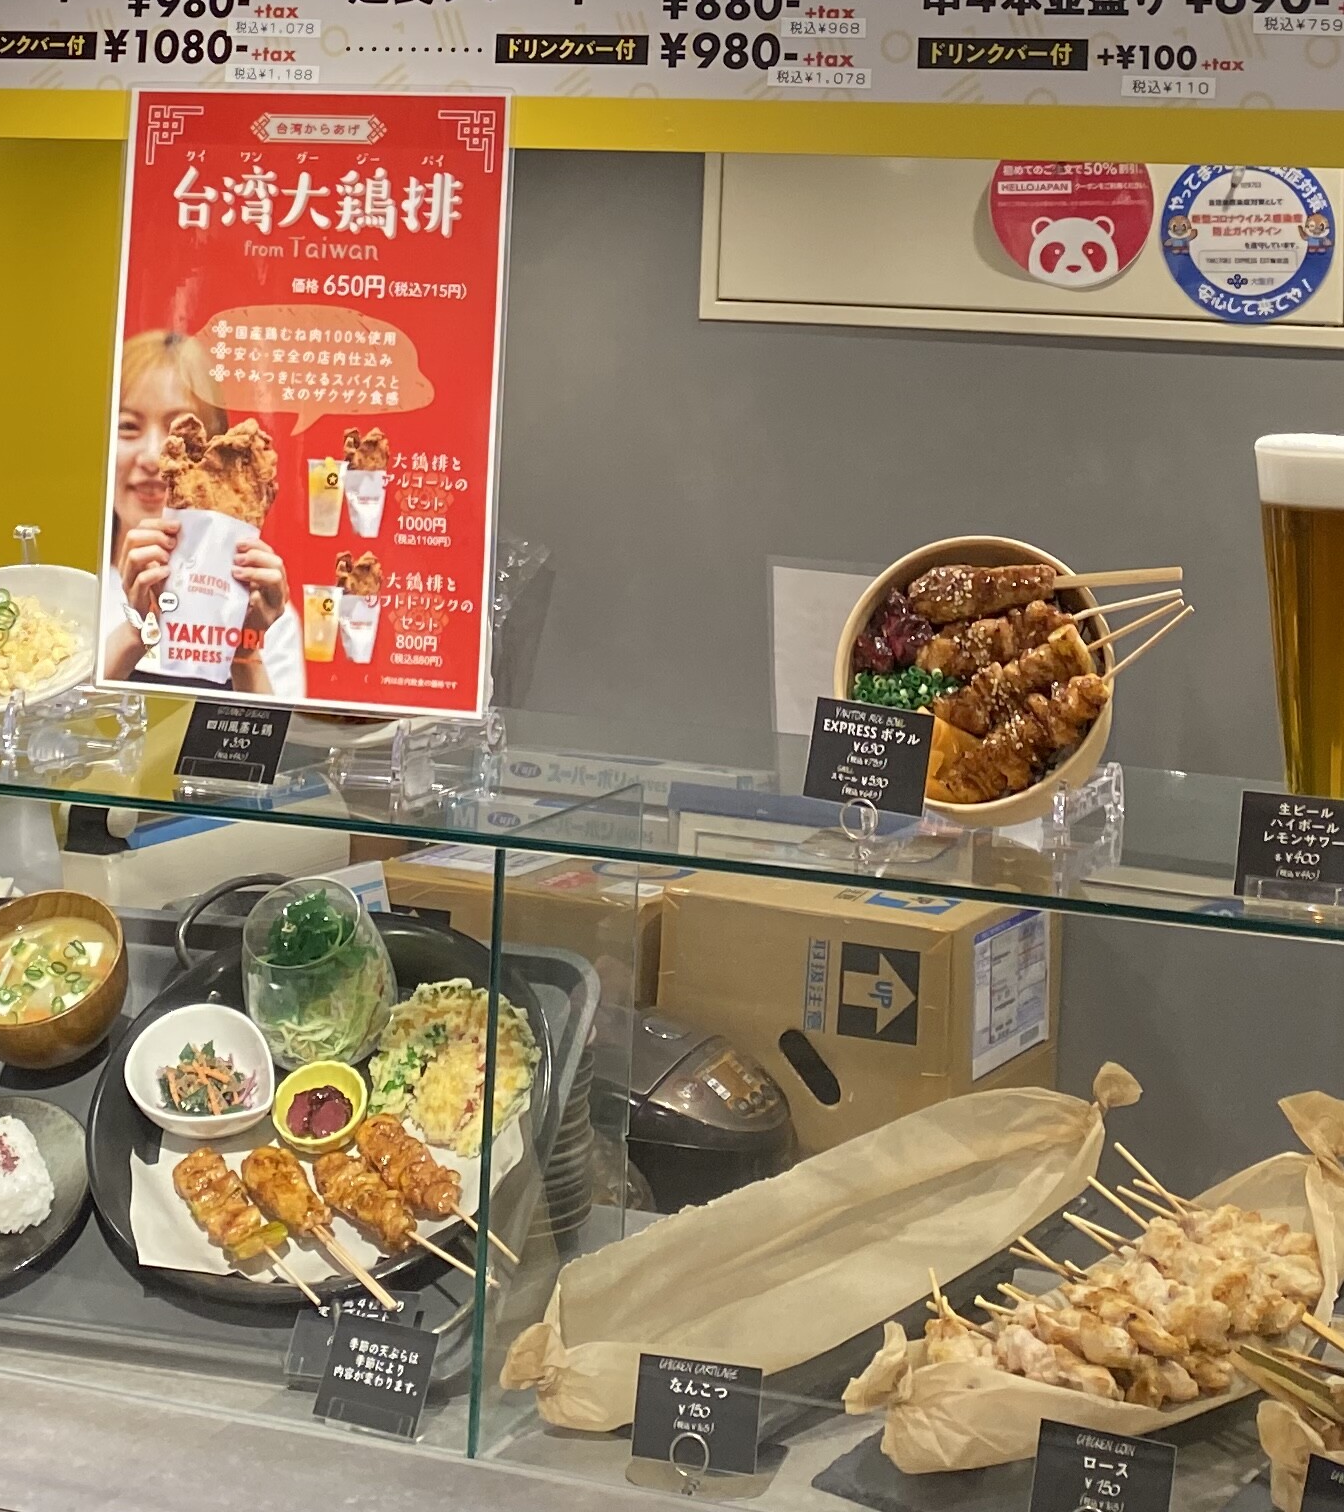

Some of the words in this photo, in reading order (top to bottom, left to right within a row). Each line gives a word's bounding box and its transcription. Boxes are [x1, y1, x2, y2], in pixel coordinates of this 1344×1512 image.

[254, 3, 299, 20] +tax
[805, 4, 855, 19] +tax
[789, 20, 861, 36] 税込¥968
[1263, 16, 1344, 32] 税込¥759
[251, 46, 297, 63] +tax
[507, 38, 636, 61] ドリンクバー付
[802, 50, 854, 68] +tax
[929, 43, 1073, 65] ドリンクバー付
[1097, 45, 1197, 72] +¥100
[1201, 57, 1244, 72] +tax
[1132, 79, 1209, 96] 税込¥110
[276, 122, 361, 137] 台湾からあげ
[173, 165, 465, 240] 台湾大鶏排
[244, 240, 284, 257] from
[288, 236, 379, 261] Taiwan
[292, 277, 319, 294] 価格
[323, 275, 386, 299] 650円
[388, 282, 468, 300] (税込715円)
[235, 325, 397, 346] 国産鶏むね肉100%使用
[234, 369, 400, 390] やみつきになるスパイスと
[282, 387, 400, 406] 衣のザクザク食感
[392, 452, 462, 473] 大鶏排と
[382, 474, 468, 492] アルコールの
[406, 494, 444, 511] セット
[397, 515, 447, 533] 1000円
[387, 572, 457, 593] 大鶏排と
[400, 616, 438, 631] セット
[165, 622, 265, 649] YAKITORI
[395, 635, 437, 652] 800円
[168, 647, 222, 664] EXPRESS
[823, 718, 877, 739] EXPRESS
[881, 728, 921, 745] ボウル
[514, 762, 539, 776] Fuji
[491, 813, 518, 826] Fuji
[1279, 803, 1334, 819] 生ビール
[1270, 818, 1340, 834] ハイボール
[1264, 831, 1344, 848] レモンサワー
[867, 981, 894, 1009] UP
[356, 1354, 404, 1377] 季節により
[333, 1364, 417, 1396] 内容が変わります。
[669, 1377, 728, 1398] なんこつ
[1084, 1456, 1128, 1478] ロース
